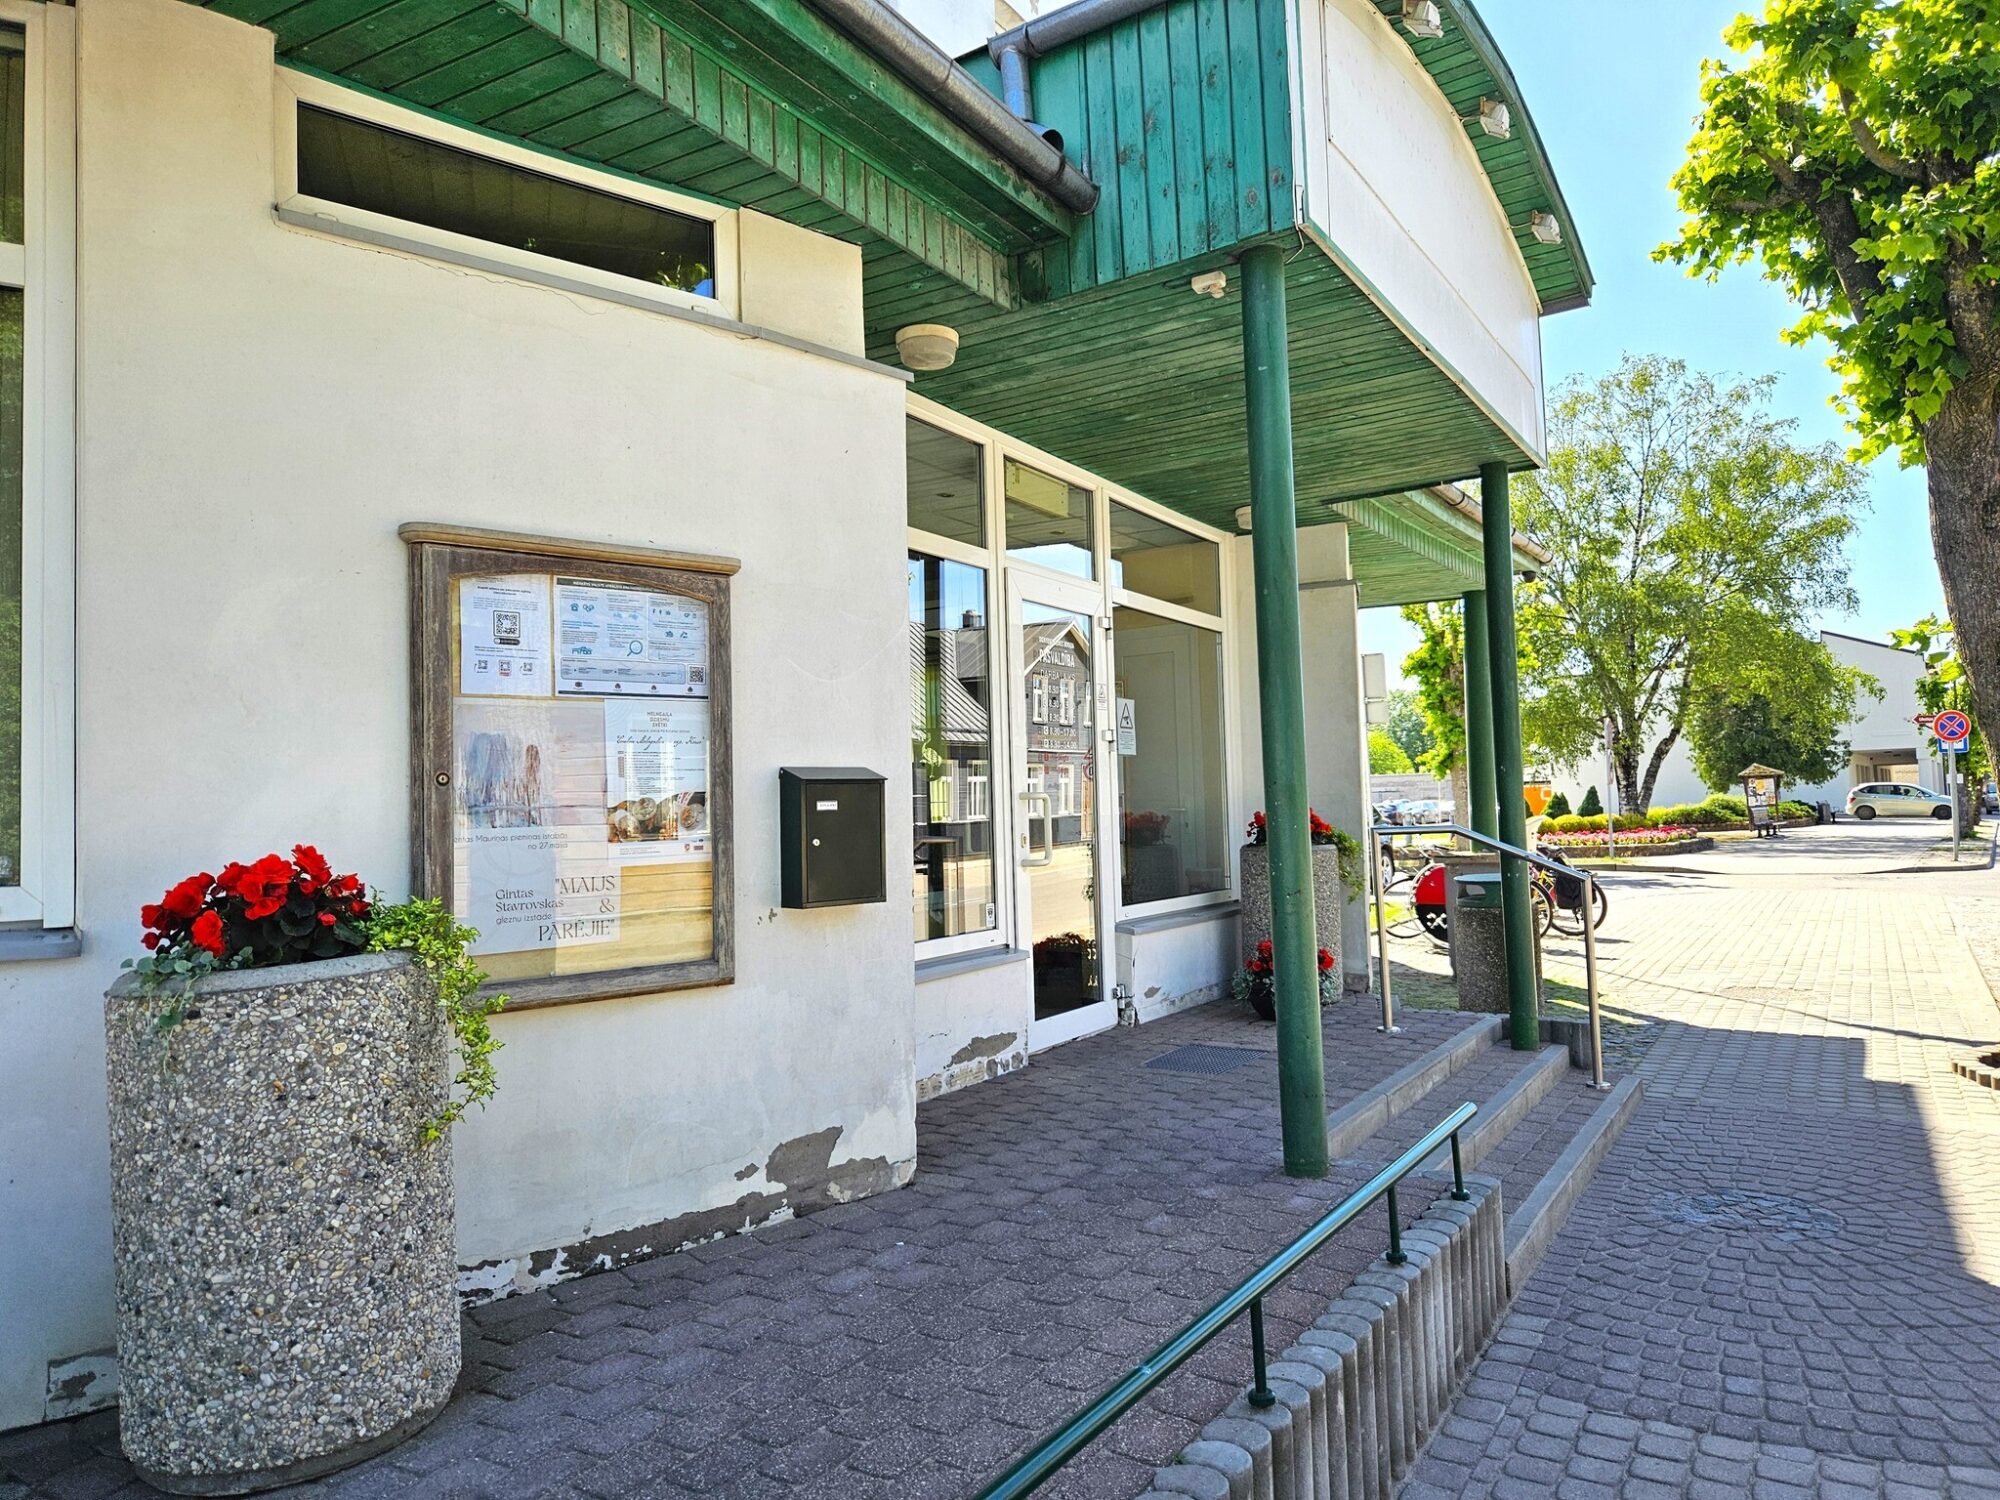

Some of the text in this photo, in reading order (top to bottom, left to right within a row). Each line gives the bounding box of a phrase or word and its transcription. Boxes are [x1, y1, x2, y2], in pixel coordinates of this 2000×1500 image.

[555, 875, 615, 894] "MAIJS
[495, 888, 534, 900] Gintas
[495, 898, 564, 912] Stavrovskas
[599, 897, 615, 913] &
[496, 914, 521, 926] gleznu
[539, 918, 615, 941] PĀRĒJIE"
